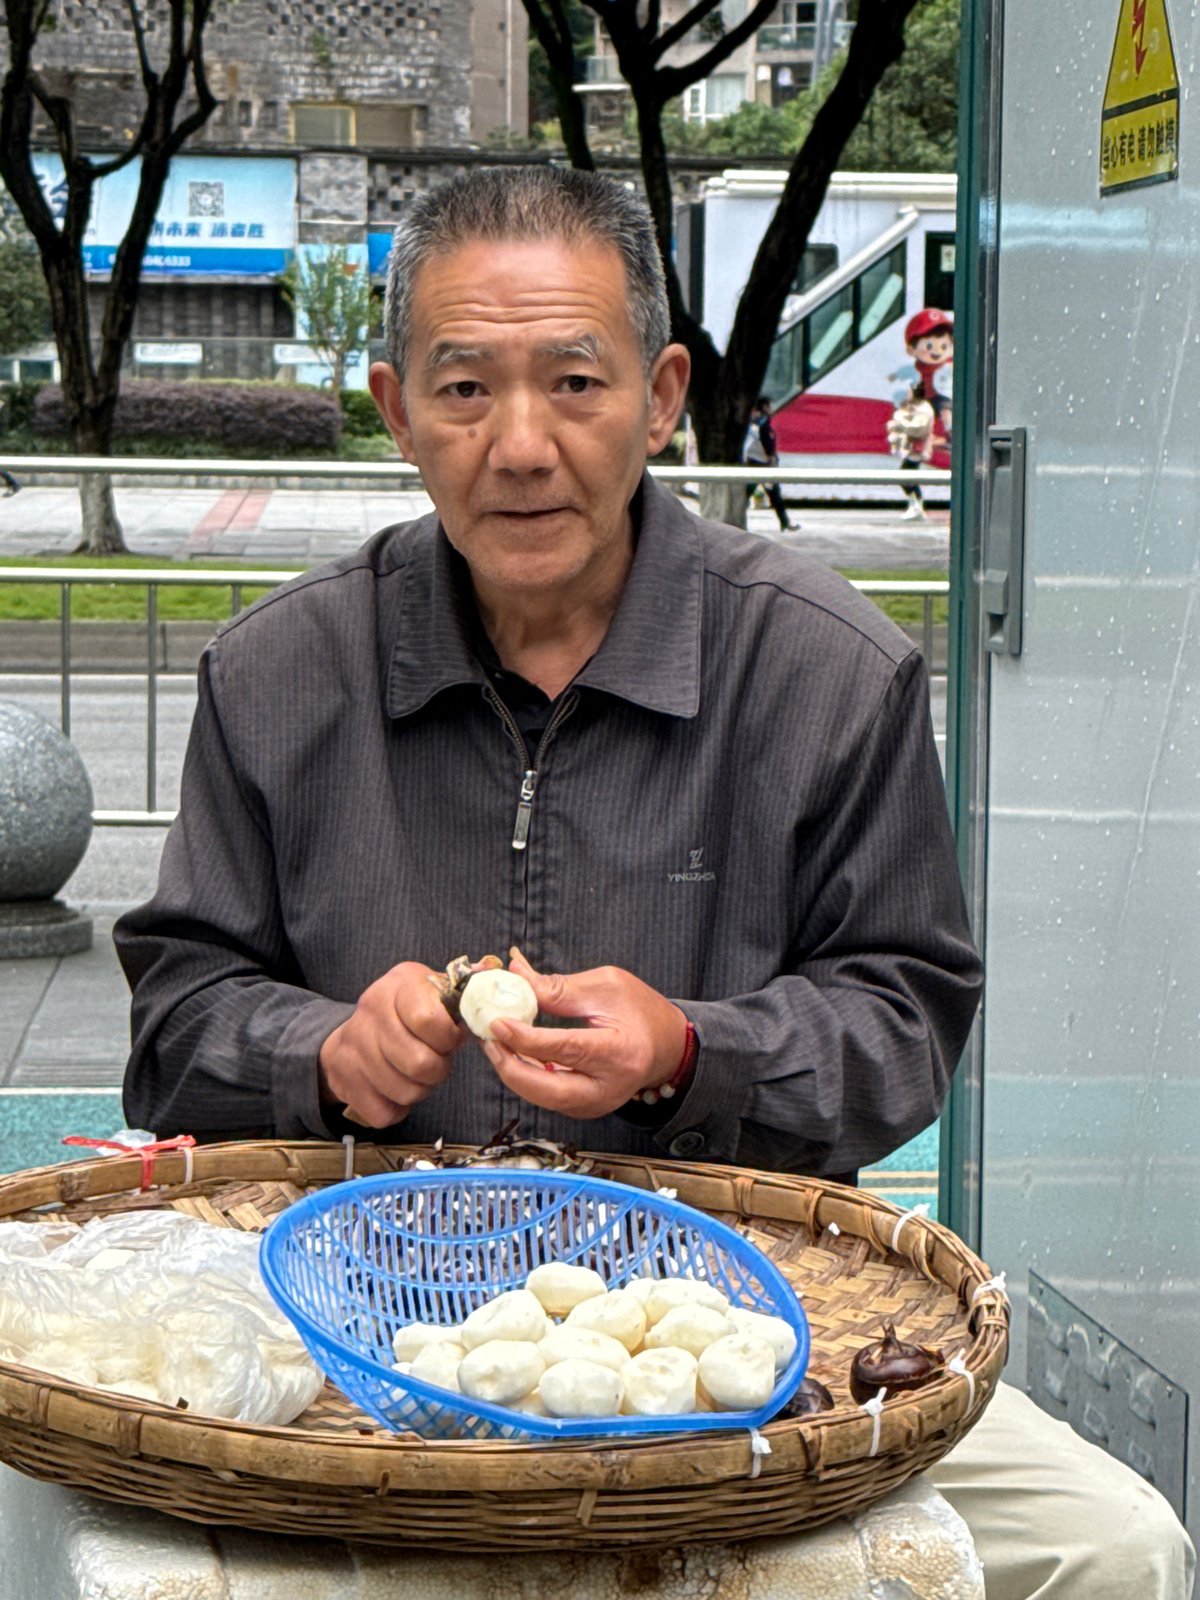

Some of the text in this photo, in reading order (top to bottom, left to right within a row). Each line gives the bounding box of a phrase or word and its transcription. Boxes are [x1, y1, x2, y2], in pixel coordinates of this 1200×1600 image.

[1102, 115, 1175, 170] 当心有电请勿触摸
